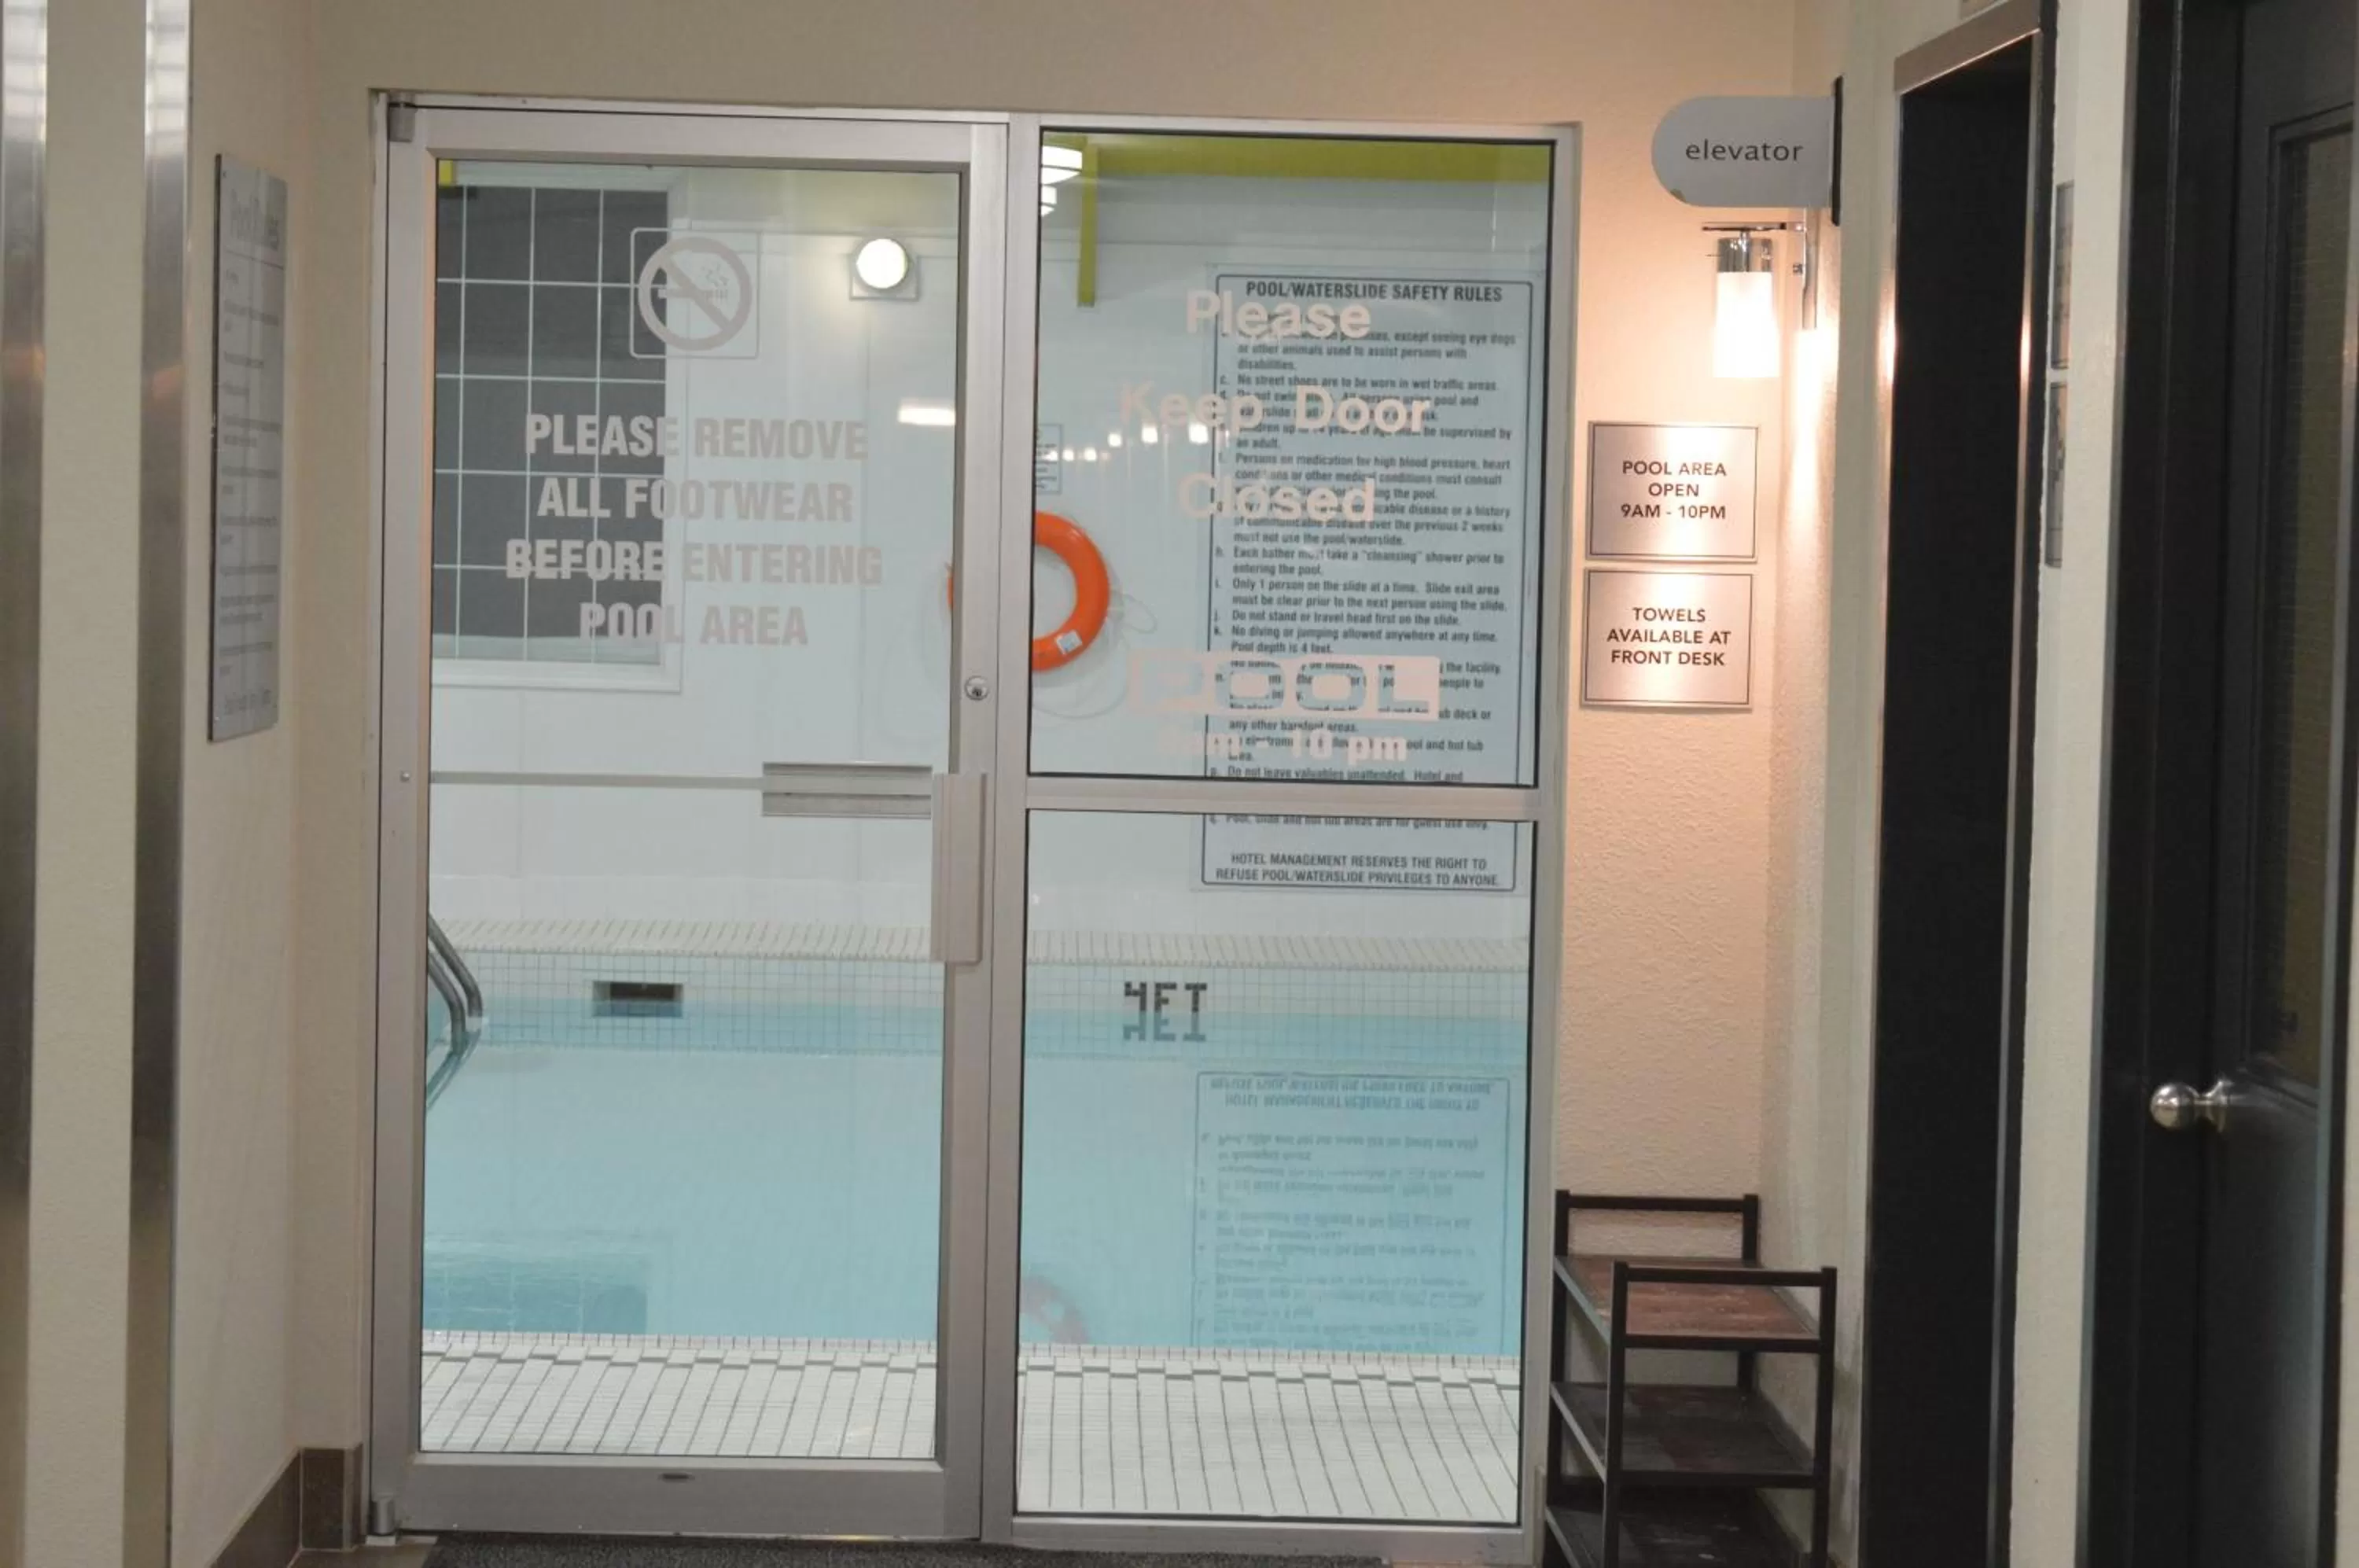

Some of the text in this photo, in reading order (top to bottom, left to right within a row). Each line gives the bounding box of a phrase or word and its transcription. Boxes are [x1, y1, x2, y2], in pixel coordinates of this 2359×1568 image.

[1685, 138, 1804, 161] elevator
[1246, 281, 1503, 303] POOL/WATERSLIDE SAFETY RULES
[1187, 289, 1371, 339] Please
[1469, 334, 1487, 346] eye
[1253, 344, 1279, 355] other
[1283, 345, 1323, 356] animals
[1326, 346, 1352, 356] used
[1354, 347, 1364, 356] to
[1368, 347, 1397, 357] assist
[1400, 348, 1441, 359] persons
[1446, 348, 1467, 359] with
[1237, 374, 1463, 391] No street are to be worn wet traffic
[1434, 395, 1479, 407] pool and
[1120, 381, 1432, 440] Keep Door
[525, 414, 870, 461] PLEASE REMOVE
[1440, 428, 1511, 441] supervised by
[1235, 453, 1277, 465] Persons
[1280, 456, 1293, 465] on
[1297, 454, 1353, 466] medication
[1356, 455, 1371, 466] for
[1374, 456, 1397, 469] high
[1399, 456, 1428, 469] blood
[1482, 458, 1511, 470] heart
[1621, 461, 1728, 477] POOL AREA
[1305, 469, 1503, 486] other conditions must consult
[1393, 488, 1437, 502] the pool.
[1647, 482, 1699, 497] OPEN
[537, 477, 854, 523] ALL FOOTWEAR
[1179, 472, 1376, 525] Closed
[1408, 504, 1511, 520] disease history
[1621, 504, 1727, 520] 9AM 10PM
[1395, 519, 1411, 531] the
[1414, 521, 1458, 534] previous
[1472, 521, 1505, 533] weeks
[1262, 532, 1279, 543] not
[1282, 534, 1300, 543] use
[1303, 532, 1319, 543] the
[505, 538, 883, 587] BEFORE ENTERING
[1234, 544, 1259, 558] Each
[1262, 547, 1295, 559] bather
[1327, 548, 1349, 560] take
[1426, 551, 1463, 564] shower
[1466, 552, 1492, 566] prior
[1232, 562, 1295, 577] entering the
[1232, 578, 1500, 596] Only person on the slide Slide exit area
[1232, 594, 1258, 605] must
[1260, 594, 1273, 605] be
[1276, 595, 1303, 606] clear
[1306, 595, 1330, 609] prior
[1347, 596, 1363, 608] the
[1366, 597, 1389, 608] next
[1391, 598, 1427, 612] person
[1430, 600, 1458, 613] using
[1460, 599, 1477, 611] the
[1232, 609, 1246, 621] Do
[1249, 610, 1266, 621] not
[1268, 610, 1297, 622] stand
[1300, 613, 1311, 622] or
[1314, 611, 1344, 624] travel
[1346, 612, 1372, 624] head
[1375, 613, 1396, 624] first
[1399, 615, 1412, 624] on
[1415, 613, 1430, 625] the
[1632, 607, 1706, 623] TOWELS
[579, 602, 809, 646] POOL AREA
[1231, 624, 1470, 644] No diving or jumping allowed anywhere at any
[1606, 628, 1732, 646] AVAILABLE AT
[1231, 639, 1286, 655] Pool depth
[1611, 650, 1726, 667] FRONT DESK
[1446, 661, 1464, 674] the
[1465, 661, 1502, 678] facility
[1141, 658, 1430, 714] POOL
[1453, 709, 1478, 722] deck
[1229, 719, 1279, 732] any other
[1288, 727, 1334, 760] 10
[1347, 736, 1407, 767] pm
[1426, 738, 1484, 752] and hot tub
[1227, 765, 1463, 782] Do not leave valuables Hotel and
[1231, 852, 1488, 870] HOTEL MANAGEMENT RESERVES THE RIGHT TO
[1216, 867, 1259, 881] REFUSE
[1261, 868, 1364, 883] POOL/WATERSLIDE
[1367, 871, 1432, 885] PRIVILEGES
[1436, 873, 1450, 885] TO
[1124, 981, 1209, 1014] 4FT
